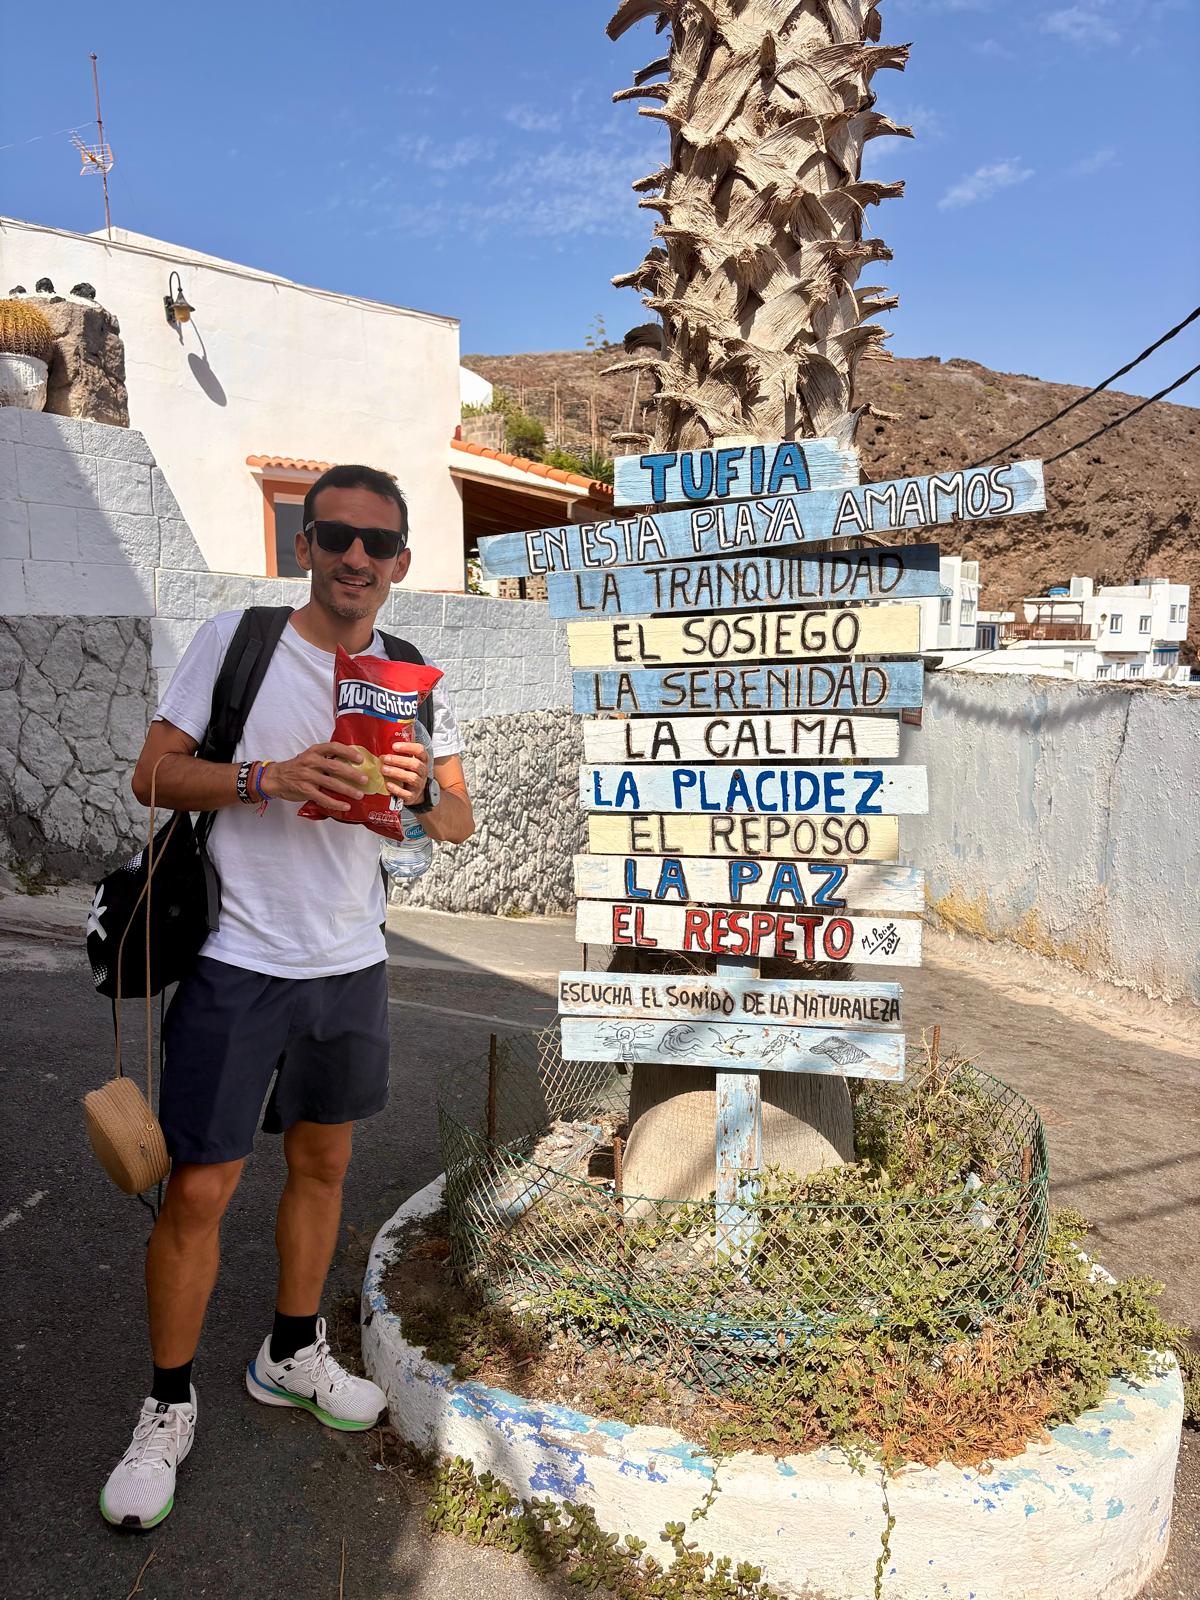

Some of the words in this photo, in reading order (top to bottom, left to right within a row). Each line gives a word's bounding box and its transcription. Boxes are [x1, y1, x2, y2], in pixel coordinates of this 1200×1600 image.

[640, 442, 811, 504] TUFIA
[525, 528, 570, 574] EN
[579, 514, 667, 568] ESTA
[691, 499, 805, 552] PLAYA
[832, 464, 1014, 535] AMAMOS
[576, 573, 622, 612] LA
[644, 552, 905, 608] TRANQUILIDAD
[613, 622, 660, 662] EL
[682, 610, 861, 659] SOSIEGO
[338, 683, 418, 716] Munchitos
[594, 673, 640, 713] LA
[662, 667, 888, 709] SERENIDAD
[625, 720, 681, 759] LA
[704, 718, 858, 758] CALMA
[593, 770, 640, 810] LA
[673, 769, 884, 814] PLACIDEZ
[629, 816, 680, 853] EL
[711, 815, 870, 855] REPOSO
[624, 859, 687, 899] LA
[729, 860, 848, 908] PAZ
[611, 905, 657, 946] EL
[683, 910, 854, 960] RESPETO
[560, 982, 633, 1006] ESCUCHA
[642, 986, 663, 1009] EL
[793, 994, 901, 1022] NATURALEZA
